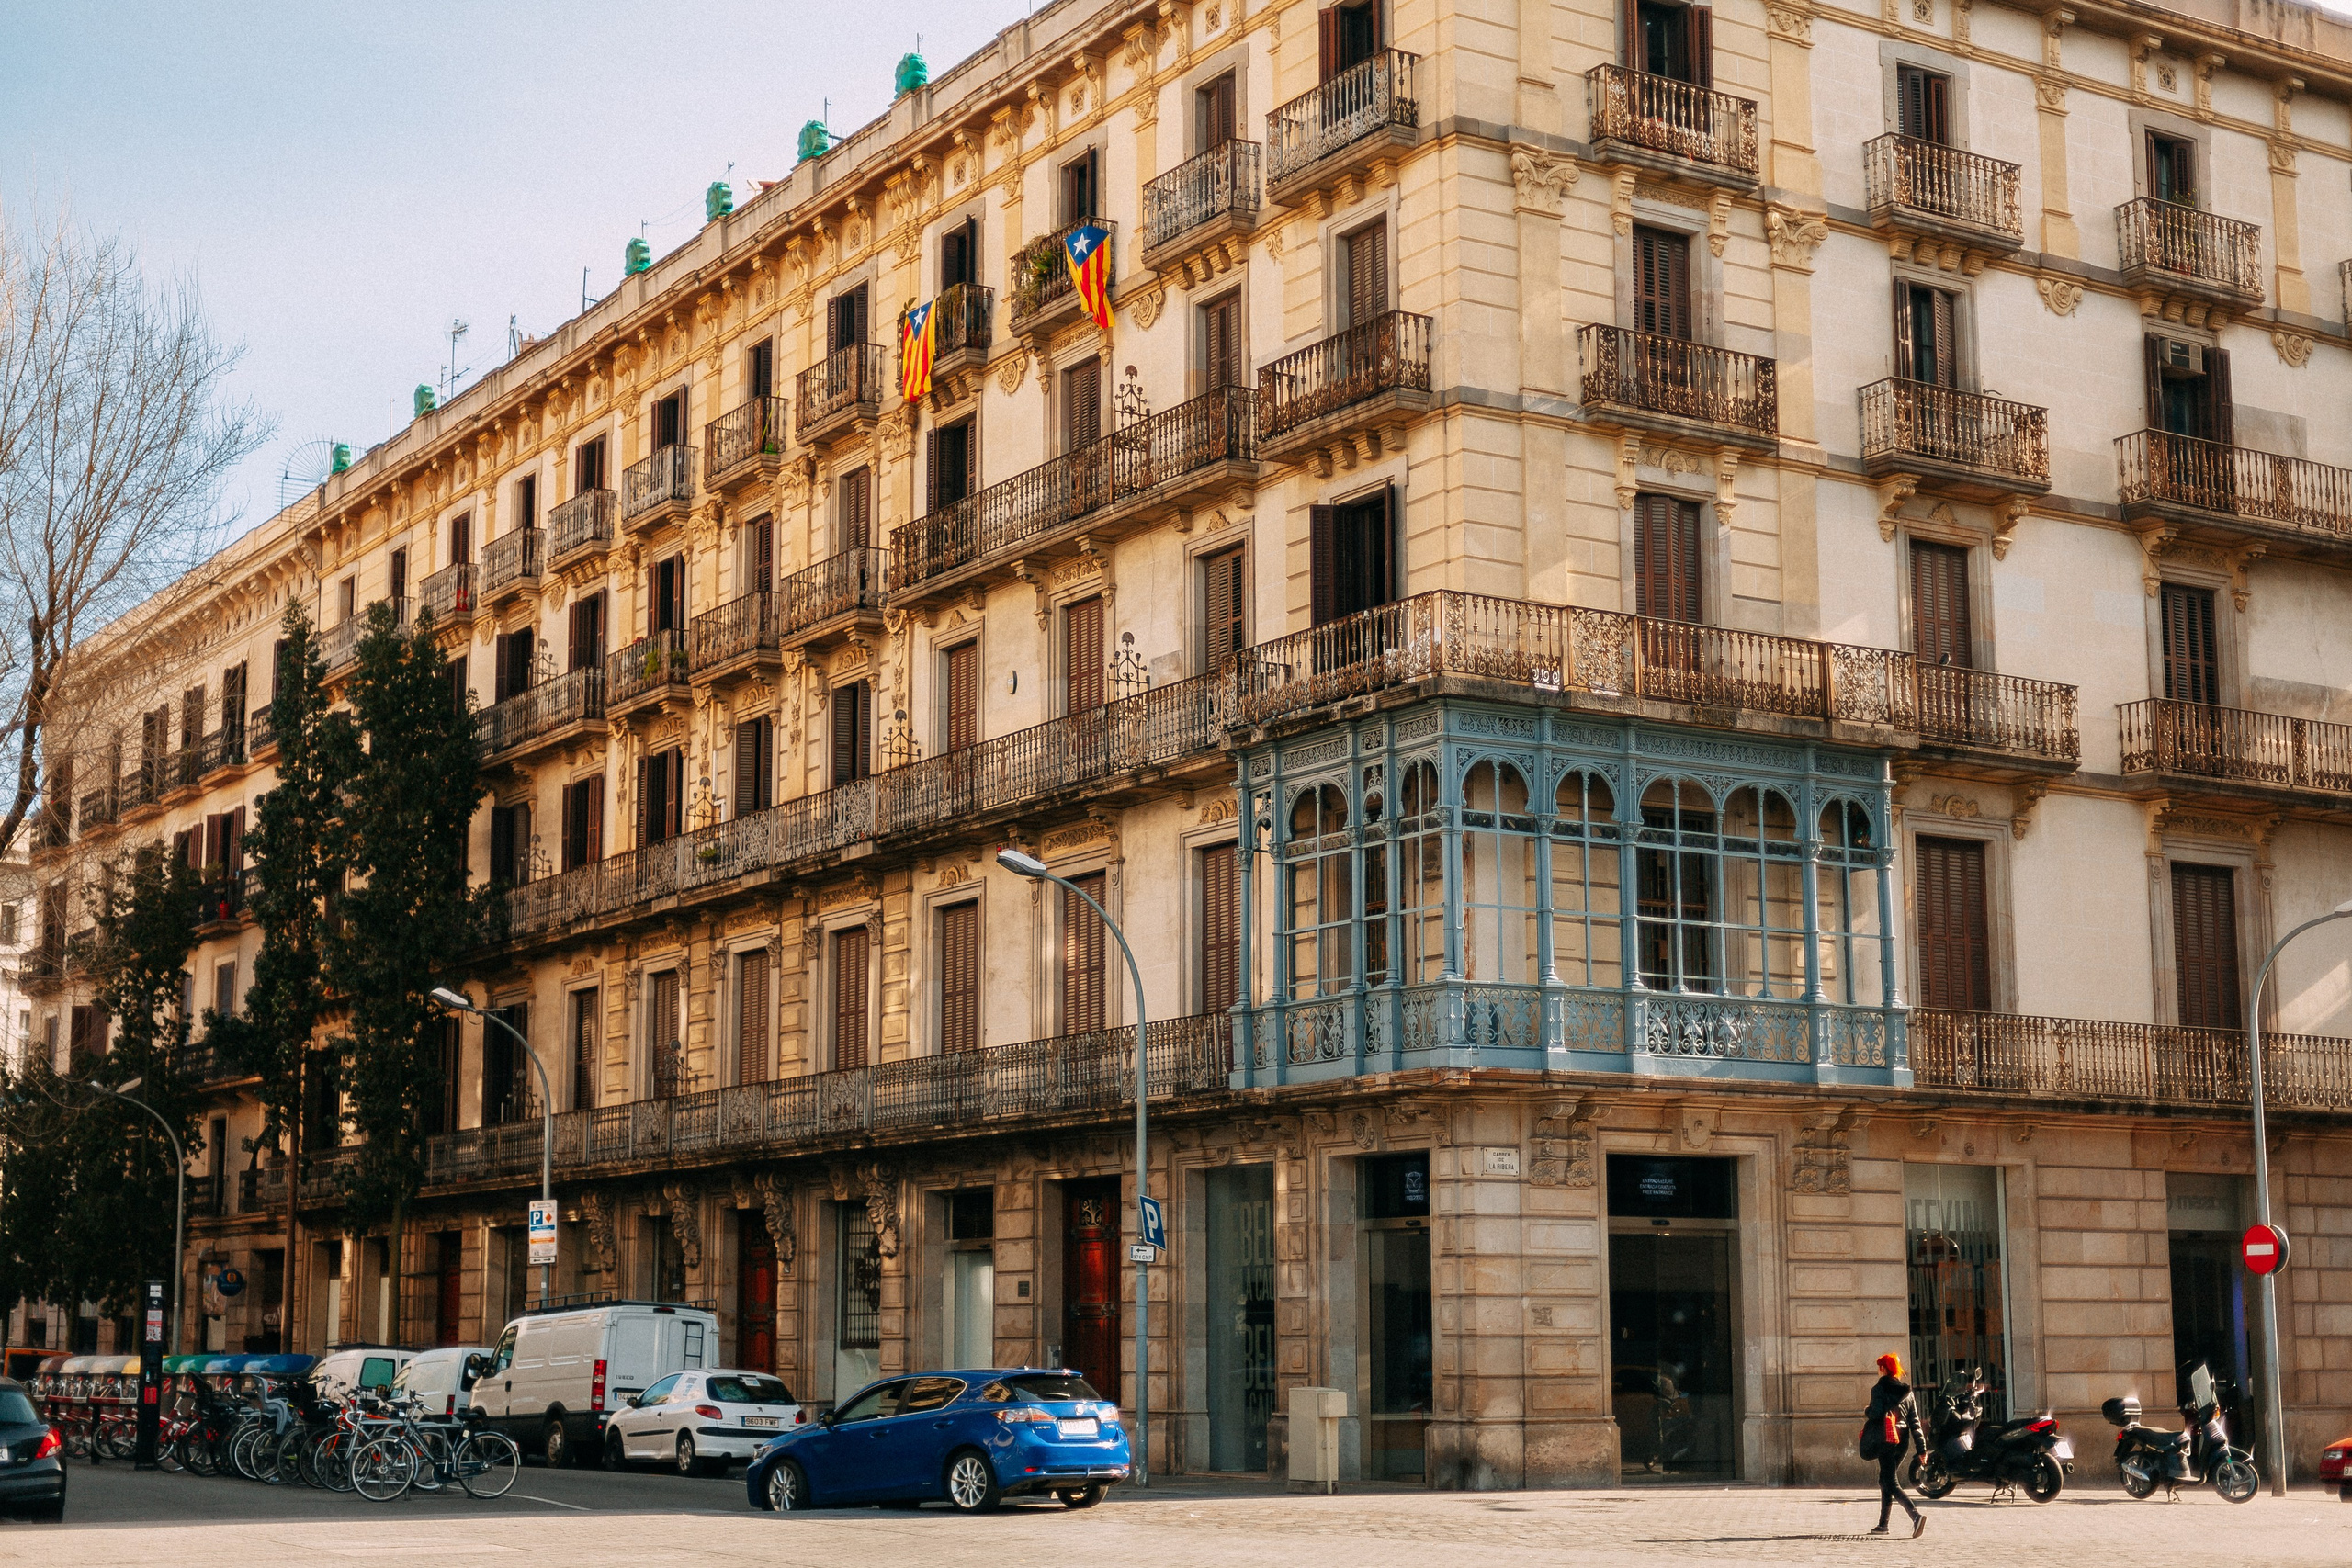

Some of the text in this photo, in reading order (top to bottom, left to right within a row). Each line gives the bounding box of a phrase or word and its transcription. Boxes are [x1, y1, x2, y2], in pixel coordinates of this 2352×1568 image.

[533, 1211, 541, 1224] P
[1144, 1202, 1159, 1239] P
[745, 1417, 763, 1426] 9603
